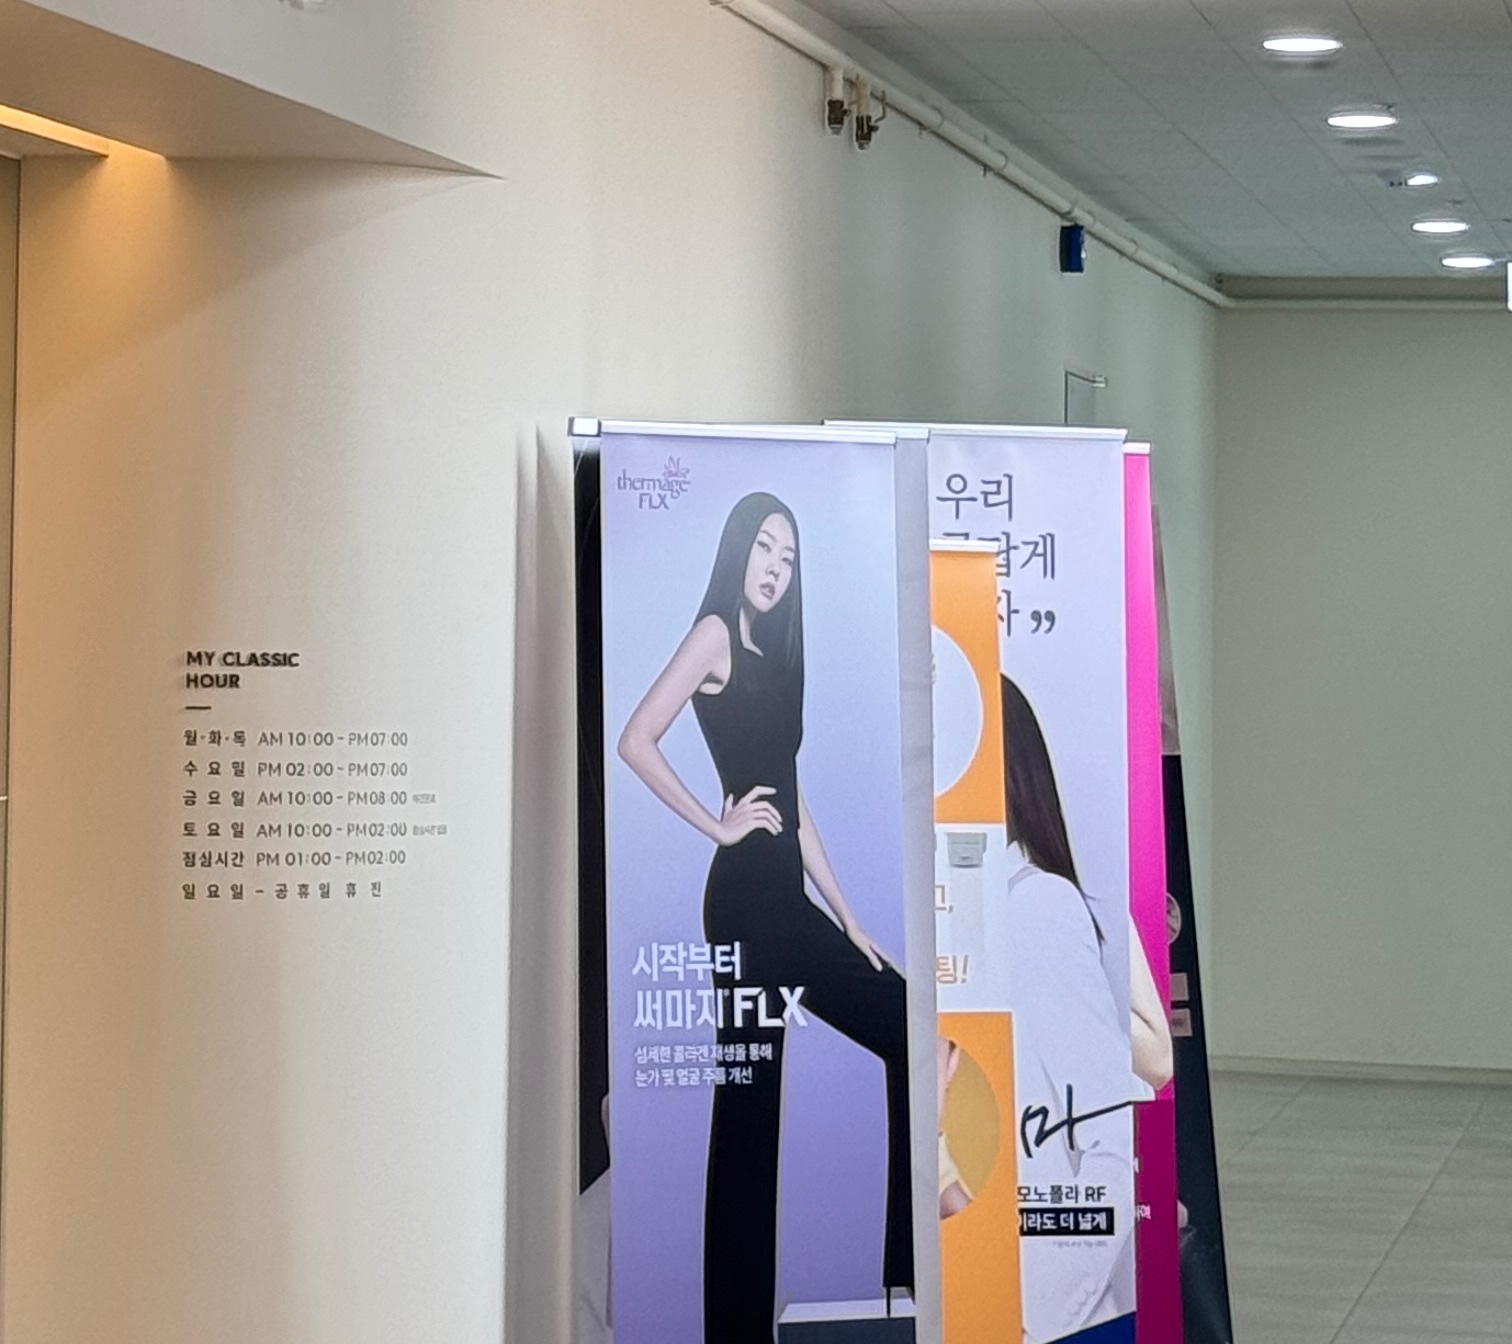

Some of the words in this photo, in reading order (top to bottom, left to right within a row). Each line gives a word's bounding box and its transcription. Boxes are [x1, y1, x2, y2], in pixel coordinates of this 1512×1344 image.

[638, 493, 669, 510] FLX
[936, 473, 1013, 522] 우리
[186, 651, 216, 667] MY
[222, 651, 300, 668] CLASSIC
[186, 673, 240, 689] HOUR
[257, 732, 283, 746] AM
[288, 732, 334, 746] 10:00
[348, 732, 368, 746] PM
[370, 732, 408, 746] 07:00
[257, 762, 281, 777] PM
[286, 762, 333, 777] 02:00
[348, 762, 368, 776] PM
[370, 762, 408, 776] 07:00
[257, 791, 282, 805] AM
[287, 791, 333, 805] 10:00
[347, 791, 368, 805] PM
[369, 791, 407, 805] 08:00
[256, 823, 282, 838] AM
[287, 823, 332, 838] 10:00
[346, 822, 367, 837] PM
[369, 822, 407, 837] 02:00
[256, 852, 280, 867] PM
[285, 852, 331, 867] 01:00
[345, 850, 366, 865] PM
[367, 850, 406, 865] 02:00
[632, 941, 741, 981] 시작부터
[733, 986, 808, 1028] FLX
[674, 1045, 709, 1064] 콜라겐
[710, 1044, 747, 1062] 재생을
[750, 1043, 773, 1061] 통해
[635, 1069, 659, 1087] 눈가
[677, 1068, 700, 1086] 얼굴
[702, 1067, 726, 1086] 주름
[728, 1066, 753, 1085] 개선
[1085, 1186, 1107, 1202] RF
[1060, 1211, 1074, 1231] 더
